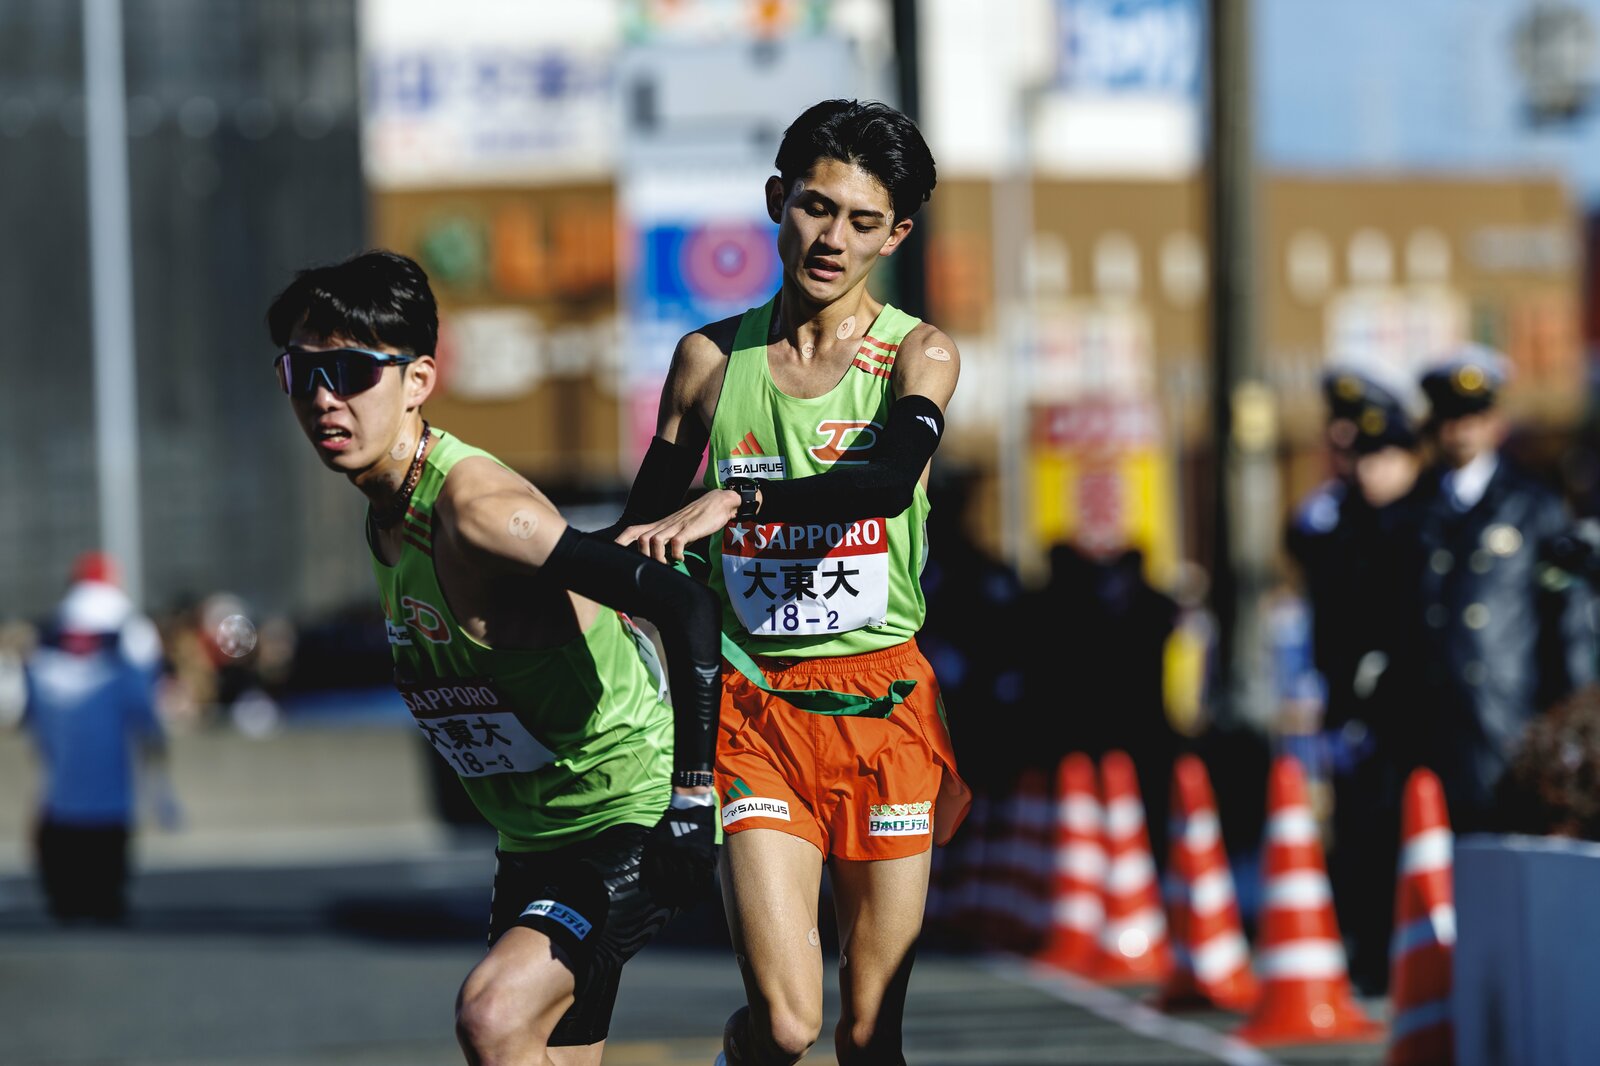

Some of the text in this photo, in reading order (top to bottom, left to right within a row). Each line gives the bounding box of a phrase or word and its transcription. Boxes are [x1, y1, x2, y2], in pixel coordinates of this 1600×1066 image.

[733, 462, 784, 475] SAURUS
[754, 520, 881, 550] SAPPORO
[743, 560, 860, 601] 大東大
[766, 604, 840, 632] 18-2
[451, 752, 514, 775] 18-3
[737, 801, 788, 815] SAURUS
[870, 819, 929, 832] 日本ロジテム
